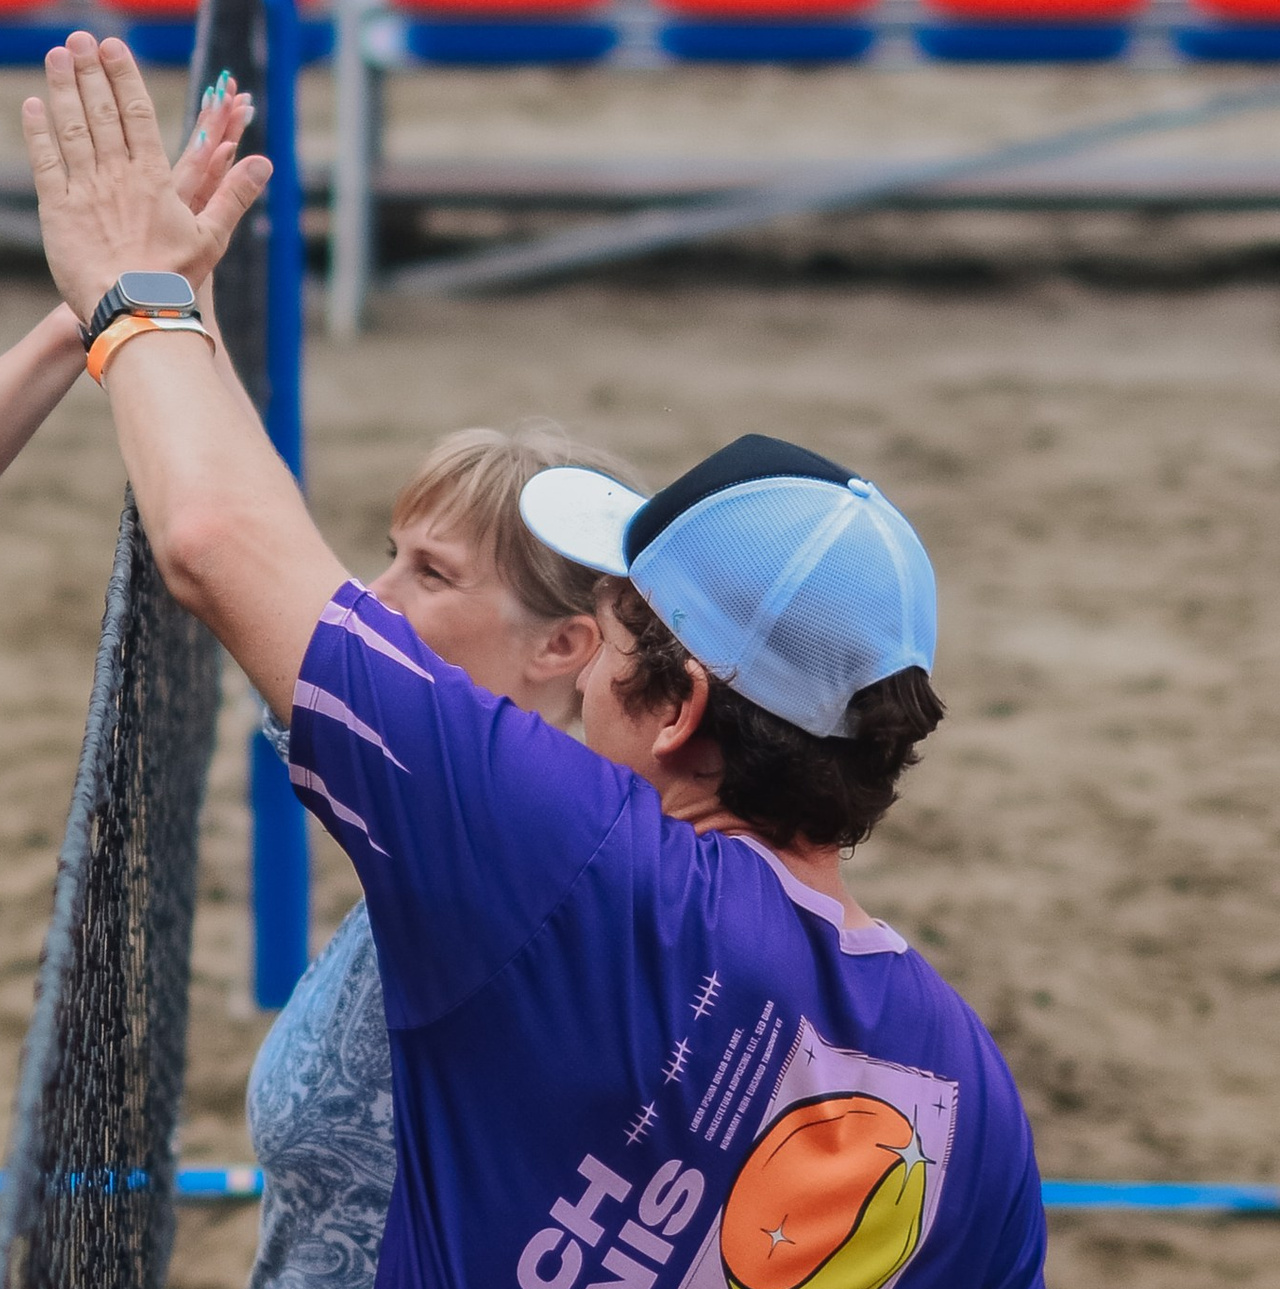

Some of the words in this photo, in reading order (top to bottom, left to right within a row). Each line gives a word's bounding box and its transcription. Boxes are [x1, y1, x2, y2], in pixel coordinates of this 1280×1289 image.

[728, 1052, 752, 1091] ADIPISCING
[755, 1020, 767, 1036] SED
[761, 1000, 774, 1021] DIAM
[774, 1017, 783, 1029] UT
[689, 1107, 705, 1132] LOREM
[701, 1084, 718, 1108] IPSUM
[712, 1061, 728, 1085] DOLOR
[723, 1048, 733, 1062] SIT
